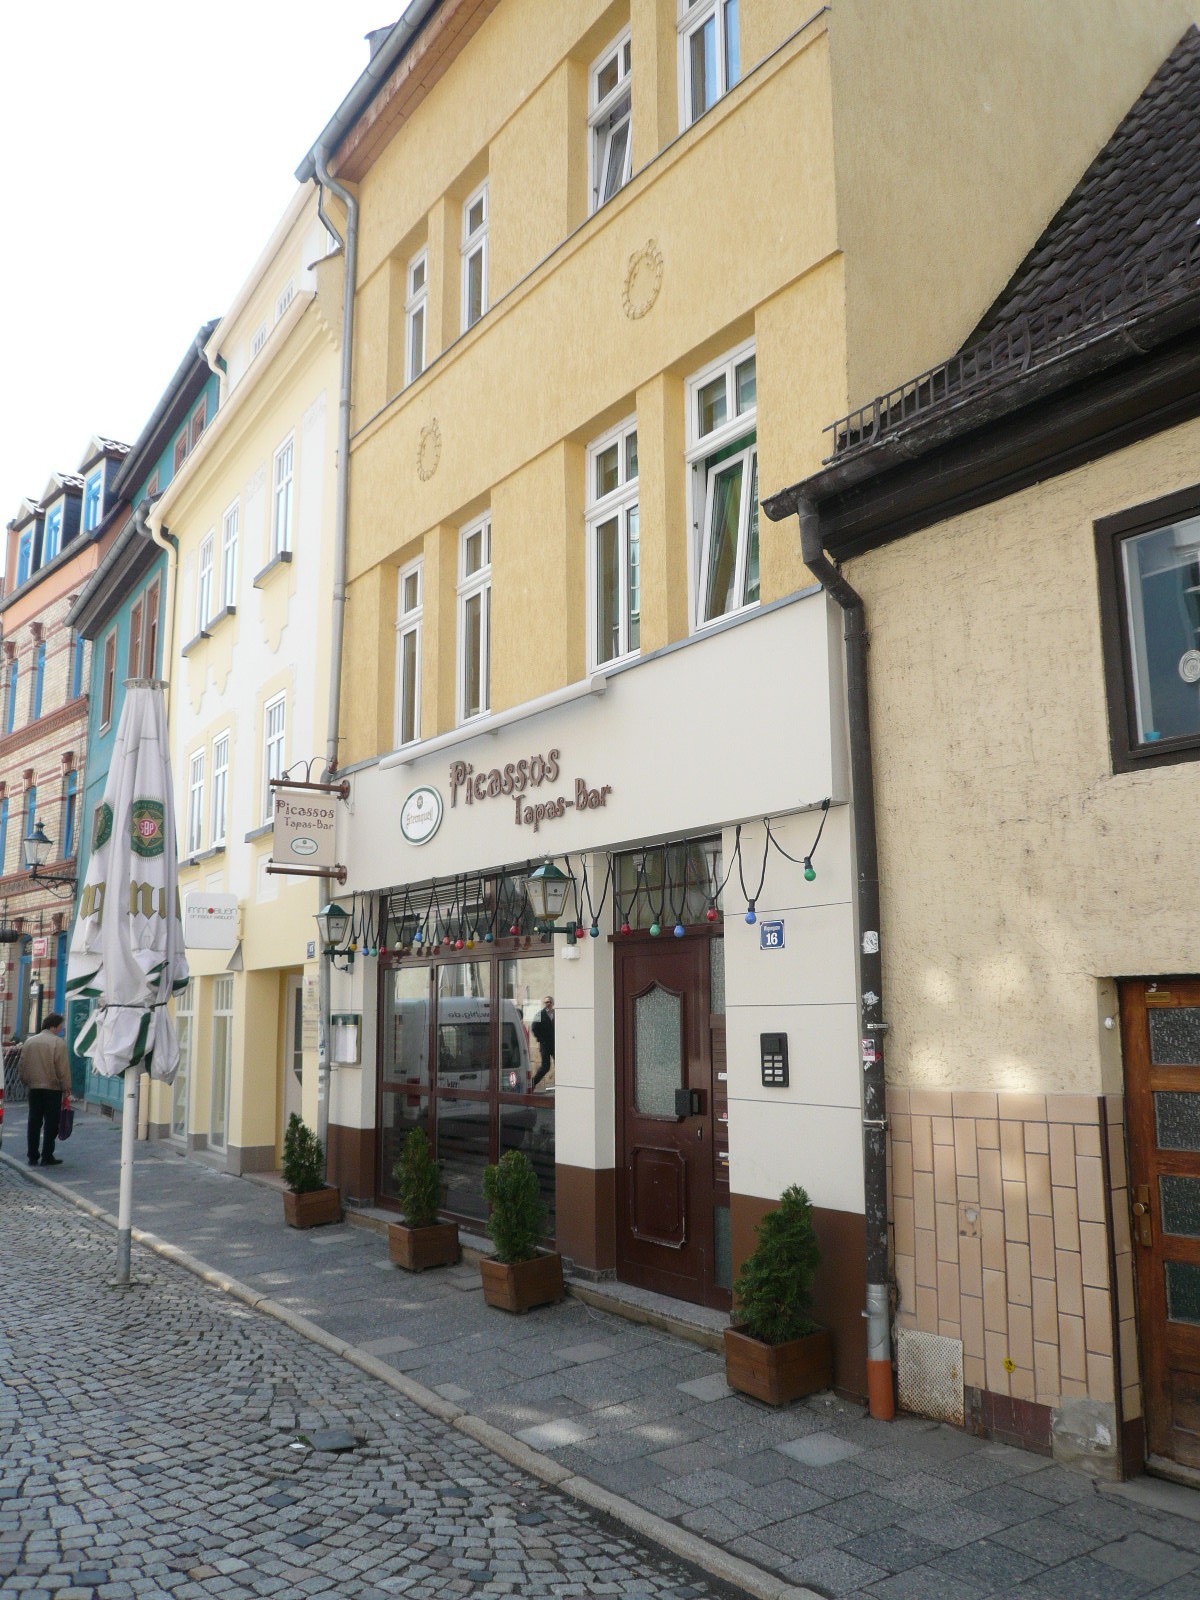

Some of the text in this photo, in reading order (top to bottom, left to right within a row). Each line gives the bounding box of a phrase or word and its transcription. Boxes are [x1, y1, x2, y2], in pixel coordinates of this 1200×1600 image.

[449, 748, 561, 808] Picassos
[275, 799, 334, 818] Picassos
[512, 777, 613, 833] Tapas-Bar
[284, 816, 334, 831] Tapas-Bar
[766, 932, 778, 946] 16
